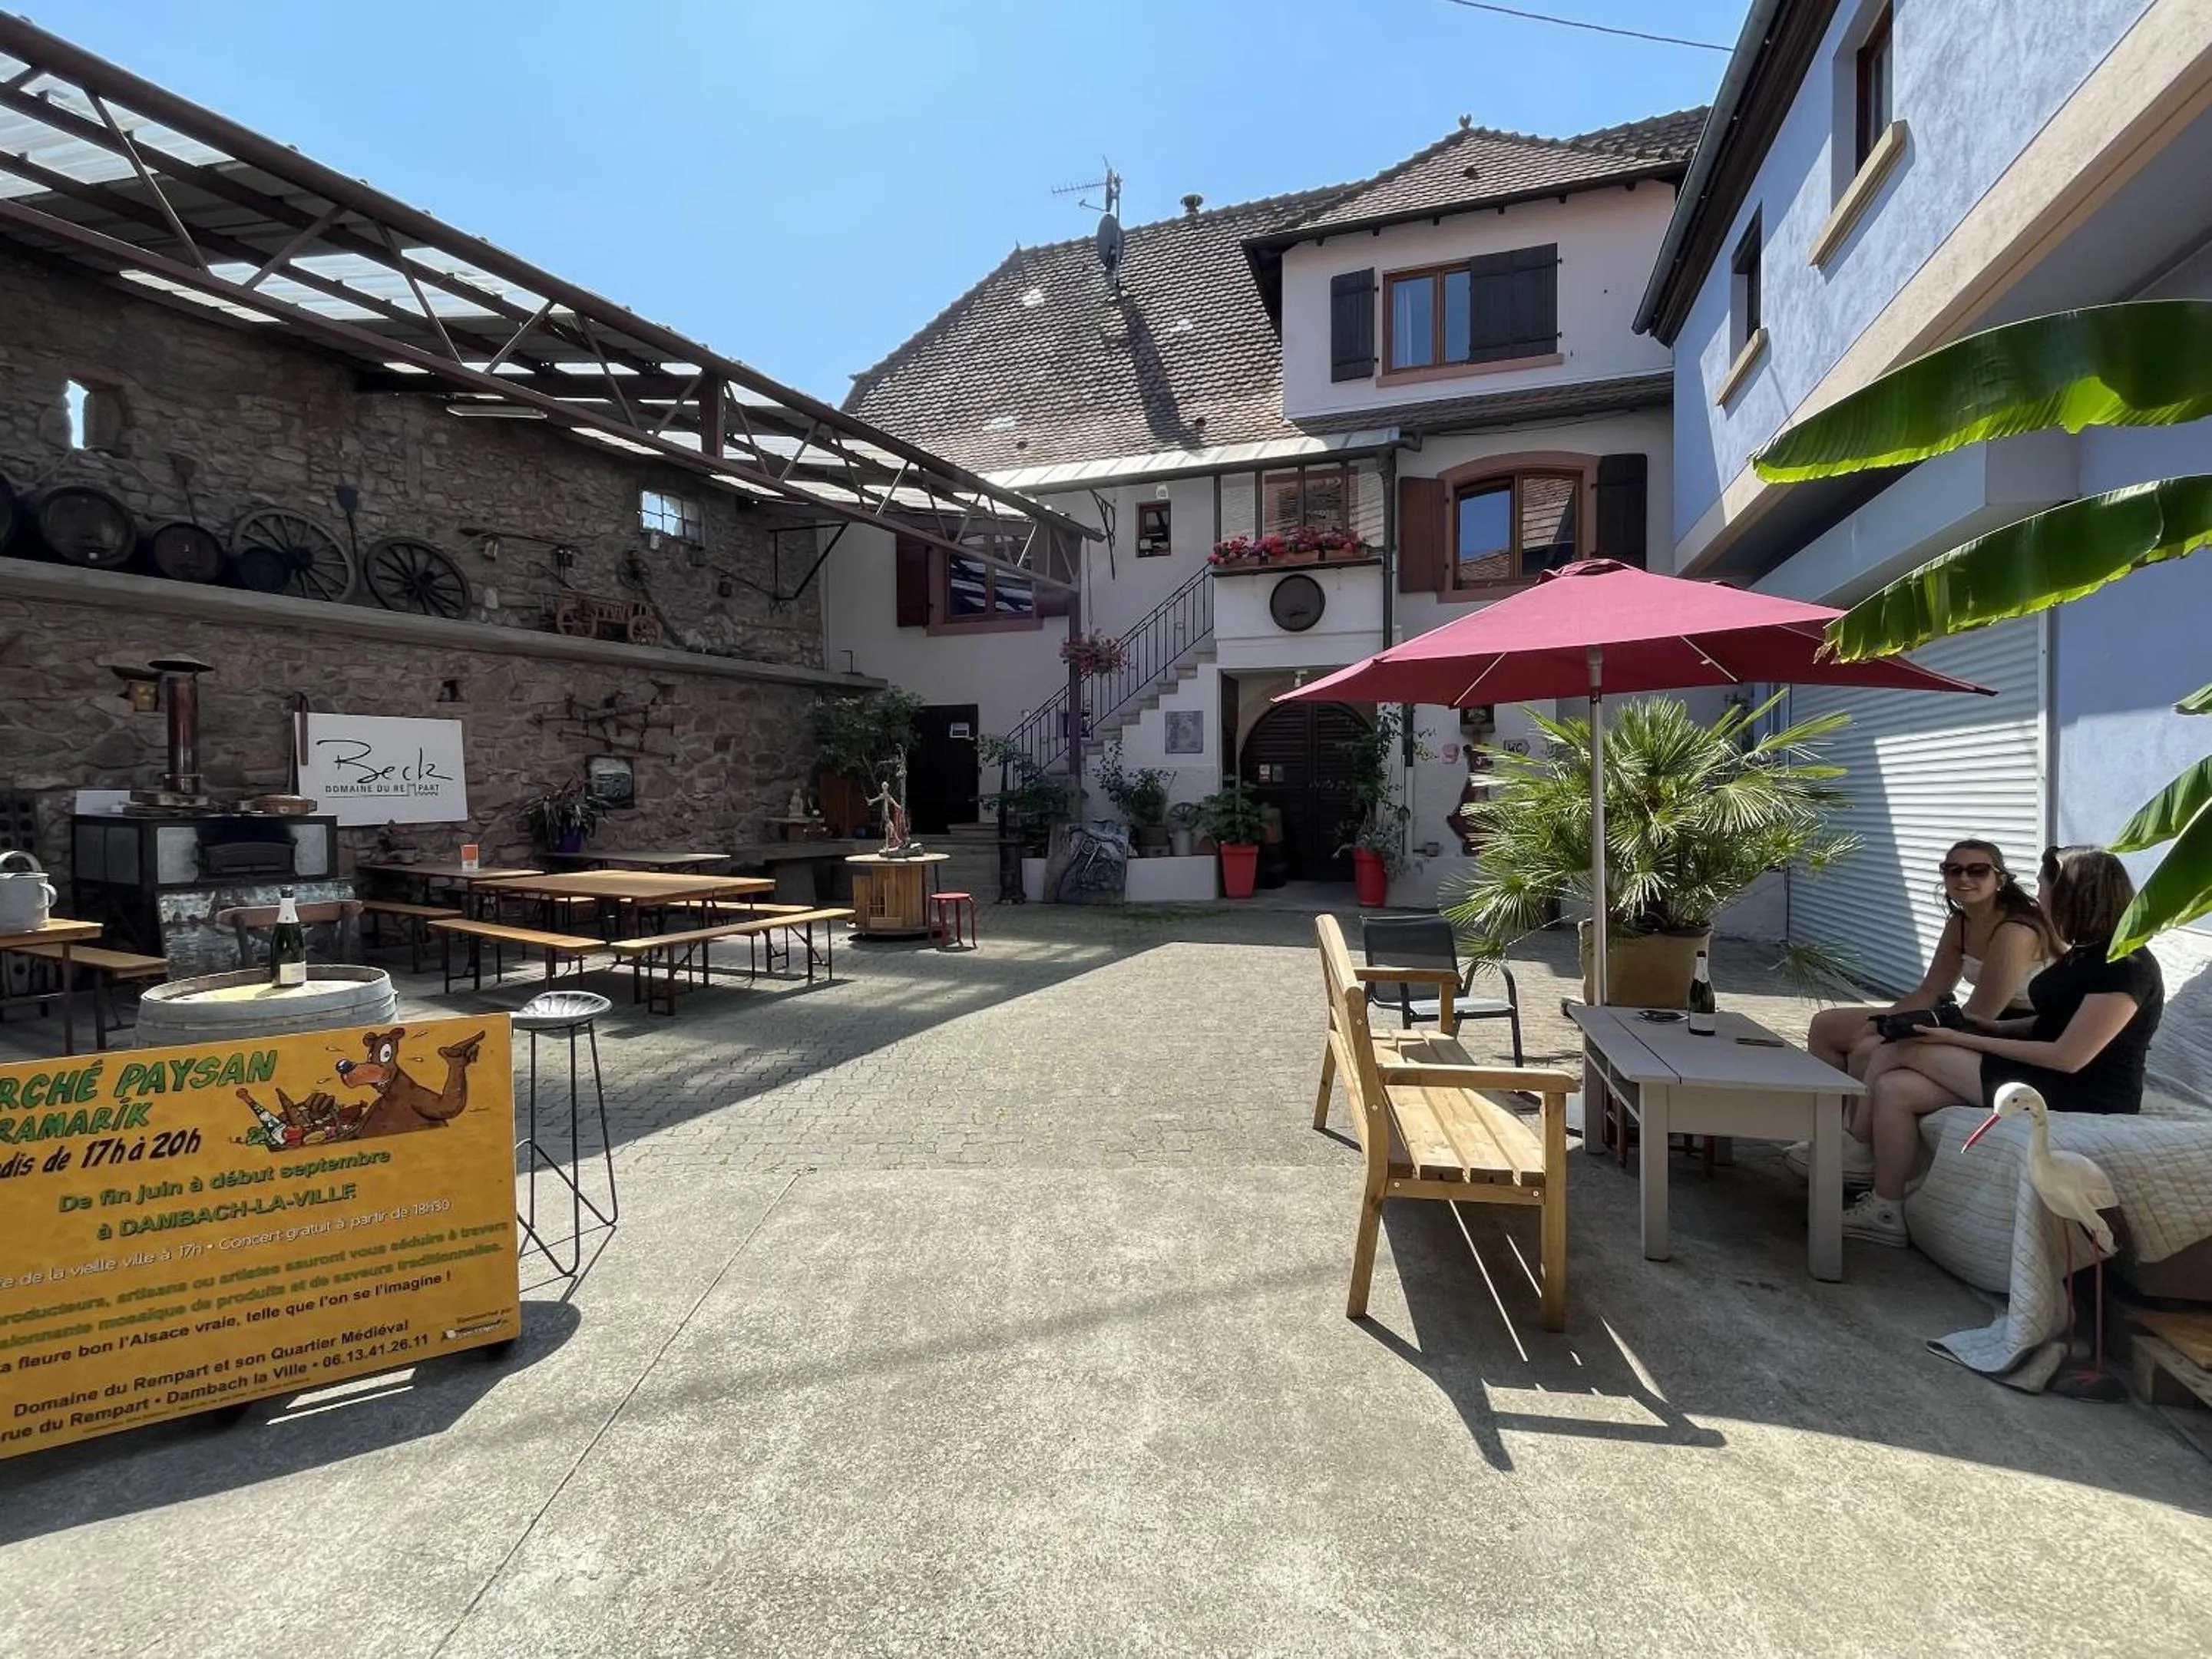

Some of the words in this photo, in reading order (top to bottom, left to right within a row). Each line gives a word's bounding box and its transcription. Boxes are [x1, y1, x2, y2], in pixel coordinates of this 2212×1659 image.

[316, 739, 453, 784] Beck
[1507, 742, 1523, 753] WC
[326, 784, 372, 793] DOMAINE
[376, 784, 389, 793] DU
[114, 1049, 277, 1098] PAYSAN
[0, 1151, 35, 1178] dis
[42, 1145, 71, 1173] de
[81, 1138, 126, 1168] 17h
[149, 1128, 201, 1159] 20h
[59, 1195, 92, 1212] De
[99, 1188, 131, 1206] fin
[136, 1181, 183, 1205] juin
[190, 1176, 203, 1192] à
[210, 1166, 273, 1189] début
[280, 1151, 392, 1178] septembre
[97, 1223, 112, 1241] à
[119, 1182, 357, 1237] DAMBACH-LA-VILLE
[20, 1271, 42, 1286] de
[50, 1267, 65, 1280] la
[71, 1257, 117, 1274] vieille
[123, 1252, 154, 1267] ville
[179, 1244, 203, 1258] 17h
[219, 1229, 282, 1251] Concert
[286, 1221, 331, 1241] gratuit
[350, 1210, 386, 1229] partir
[391, 1208, 408, 1221] de
[193, 1277, 214, 1290] ou
[349, 1244, 387, 1260] vous
[190, 1298, 211, 1312] de
[217, 1285, 286, 1310] produits
[291, 1280, 306, 1292] et
[309, 1275, 329, 1288] de
[333, 1264, 394, 1283] saveurs
[0, 1362, 12, 1373] a
[78, 1342, 113, 1357] bon
[119, 1327, 189, 1349] l'Alsace
[246, 1307, 279, 1323] telle
[286, 1300, 315, 1317] que
[319, 1294, 348, 1307] l'on
[353, 1287, 370, 1300] se
[375, 1274, 442, 1296] l'imagine
[1, 1426, 32, 1442] rue
[39, 1419, 63, 1434] du
[70, 1399, 149, 1426] Rempart
[167, 1376, 247, 1404] Dambach
[254, 1372, 267, 1384] la
[273, 1363, 307, 1379] Ville
[323, 1334, 428, 1367] 06.13.41.26.11
[14, 1390, 98, 1417] Domaine
[104, 1383, 127, 1396] du
[134, 1365, 208, 1391] Rempart
[214, 1359, 230, 1373] et
[235, 1353, 266, 1368] son
[271, 1336, 336, 1360] Quartier
[342, 1318, 408, 1343] Médiéval
